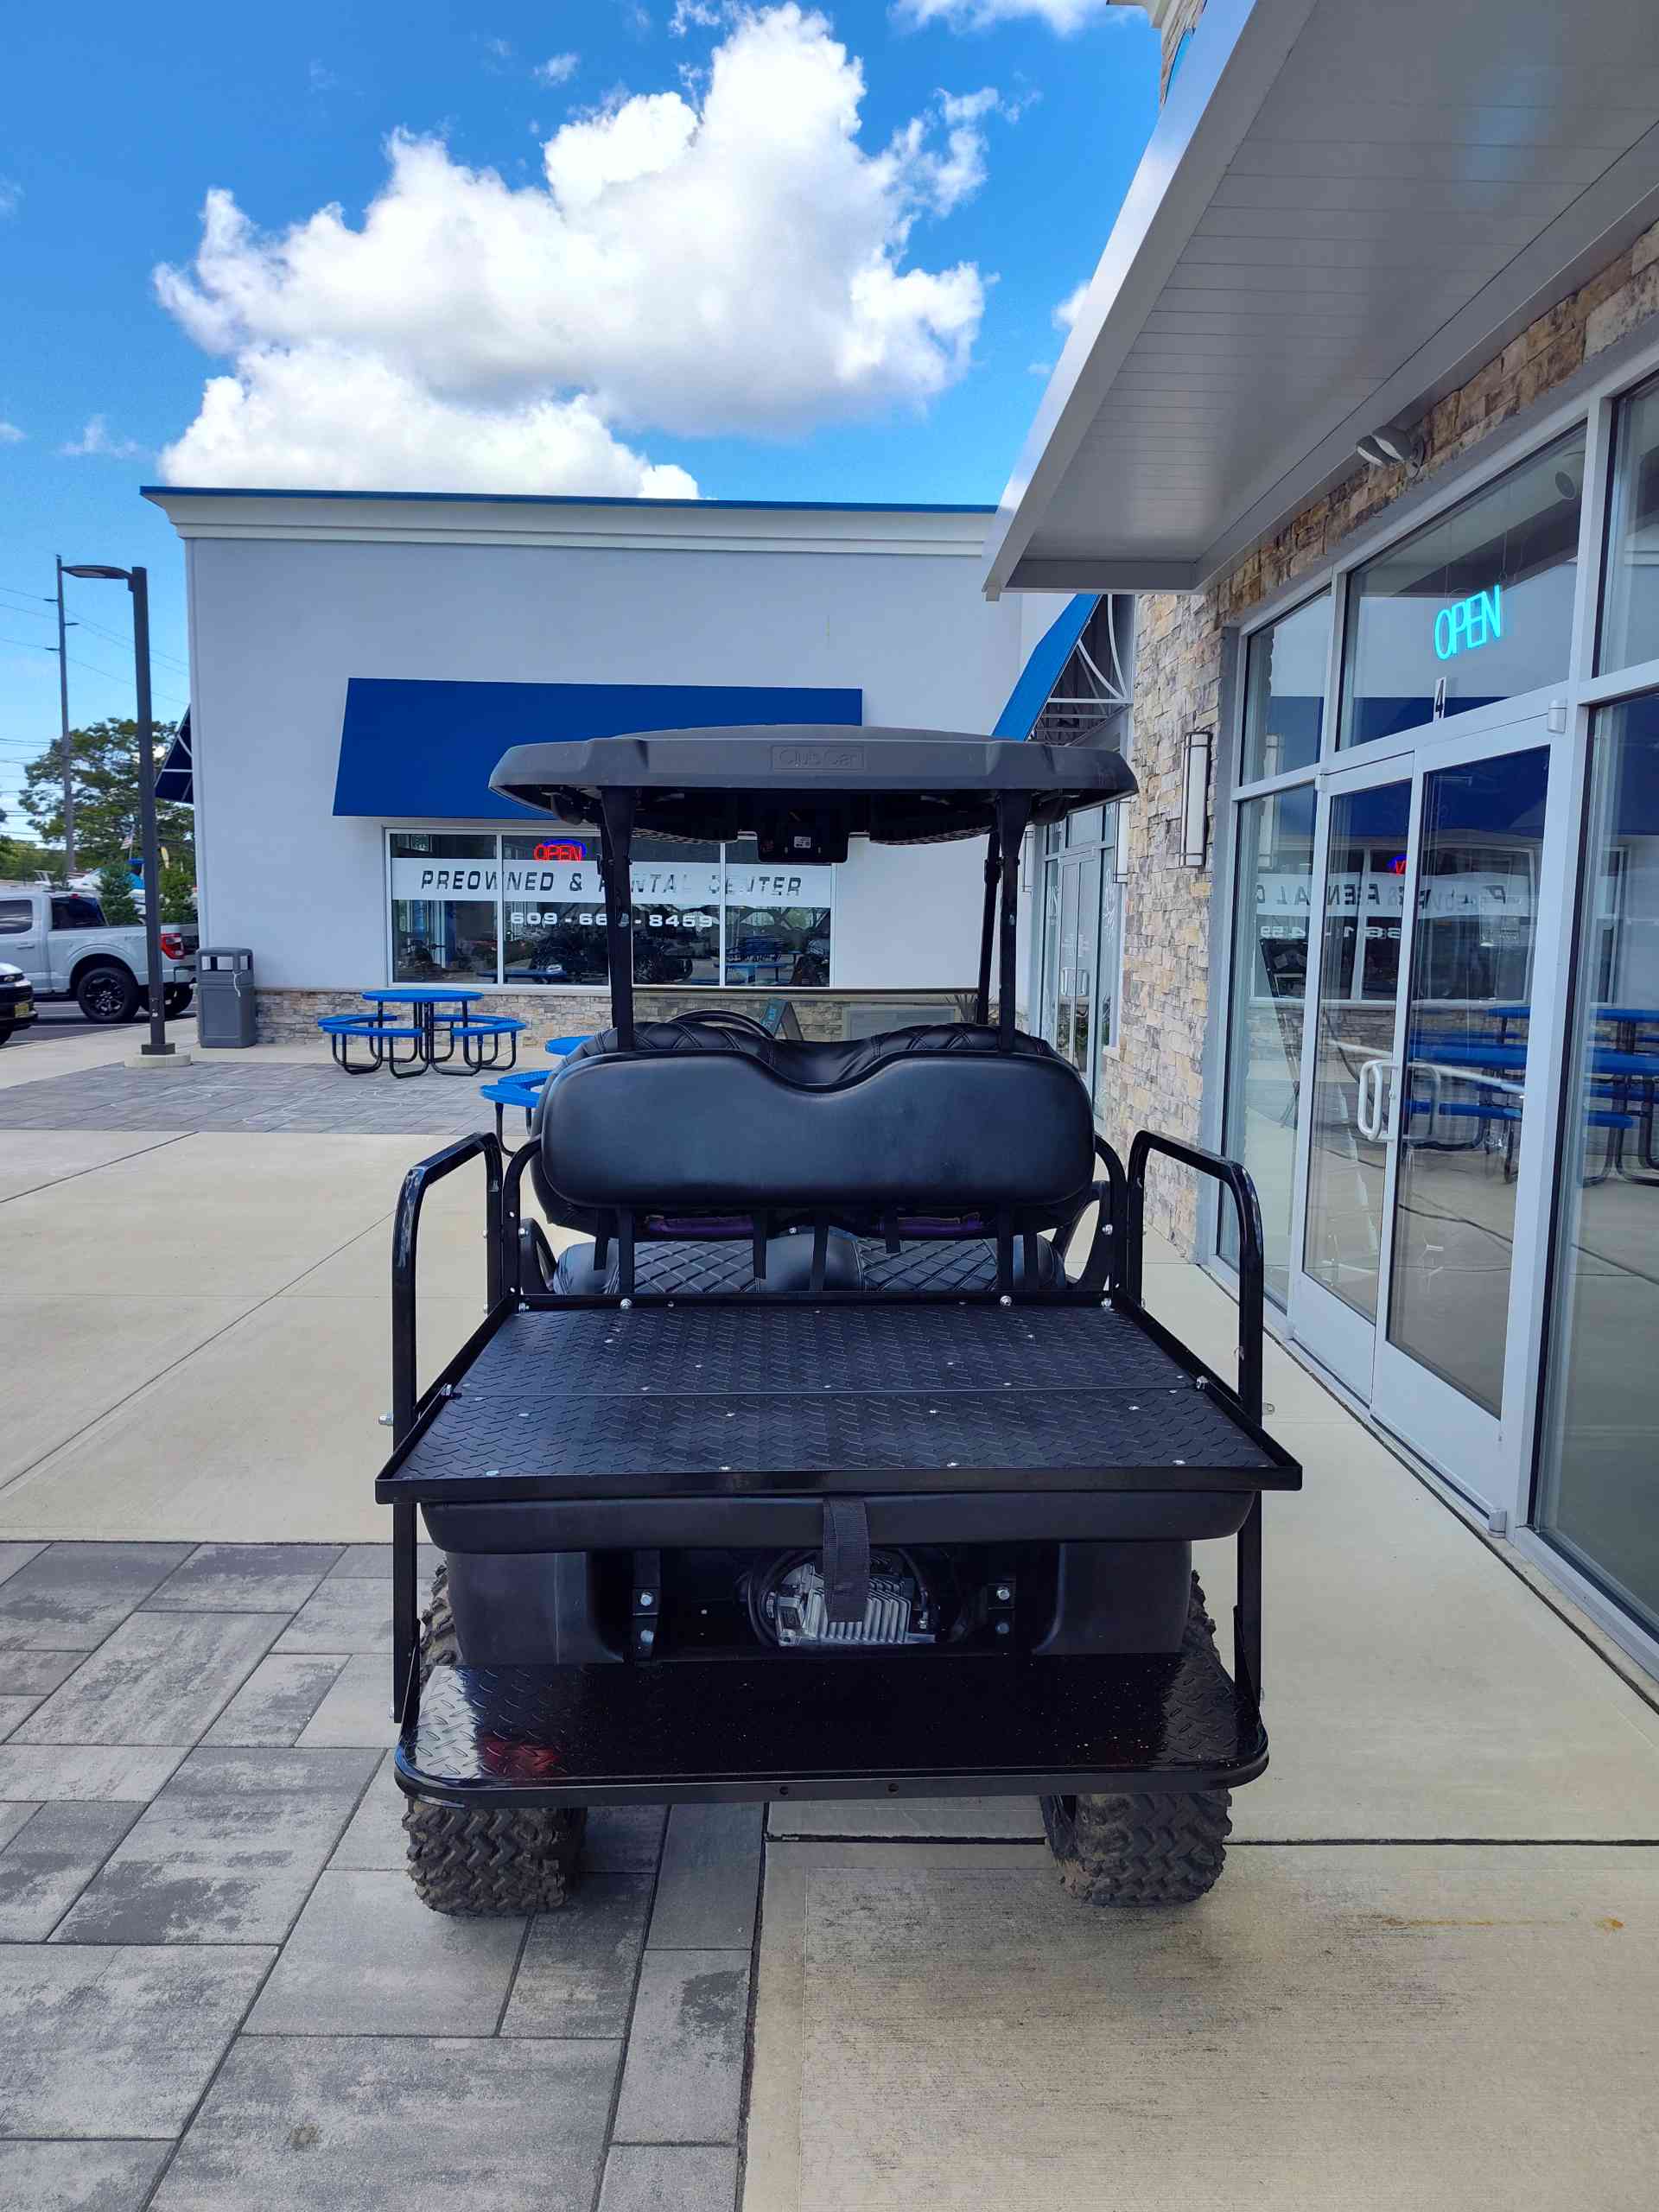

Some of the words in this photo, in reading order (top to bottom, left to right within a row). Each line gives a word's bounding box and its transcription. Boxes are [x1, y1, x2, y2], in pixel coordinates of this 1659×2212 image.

[1433, 583, 1502, 661] OPEN
[1435, 678, 1445, 719] 4
[533, 843, 582, 861] OPEN
[421, 869, 554, 891] PREOWNED
[569, 872, 582, 891] &
